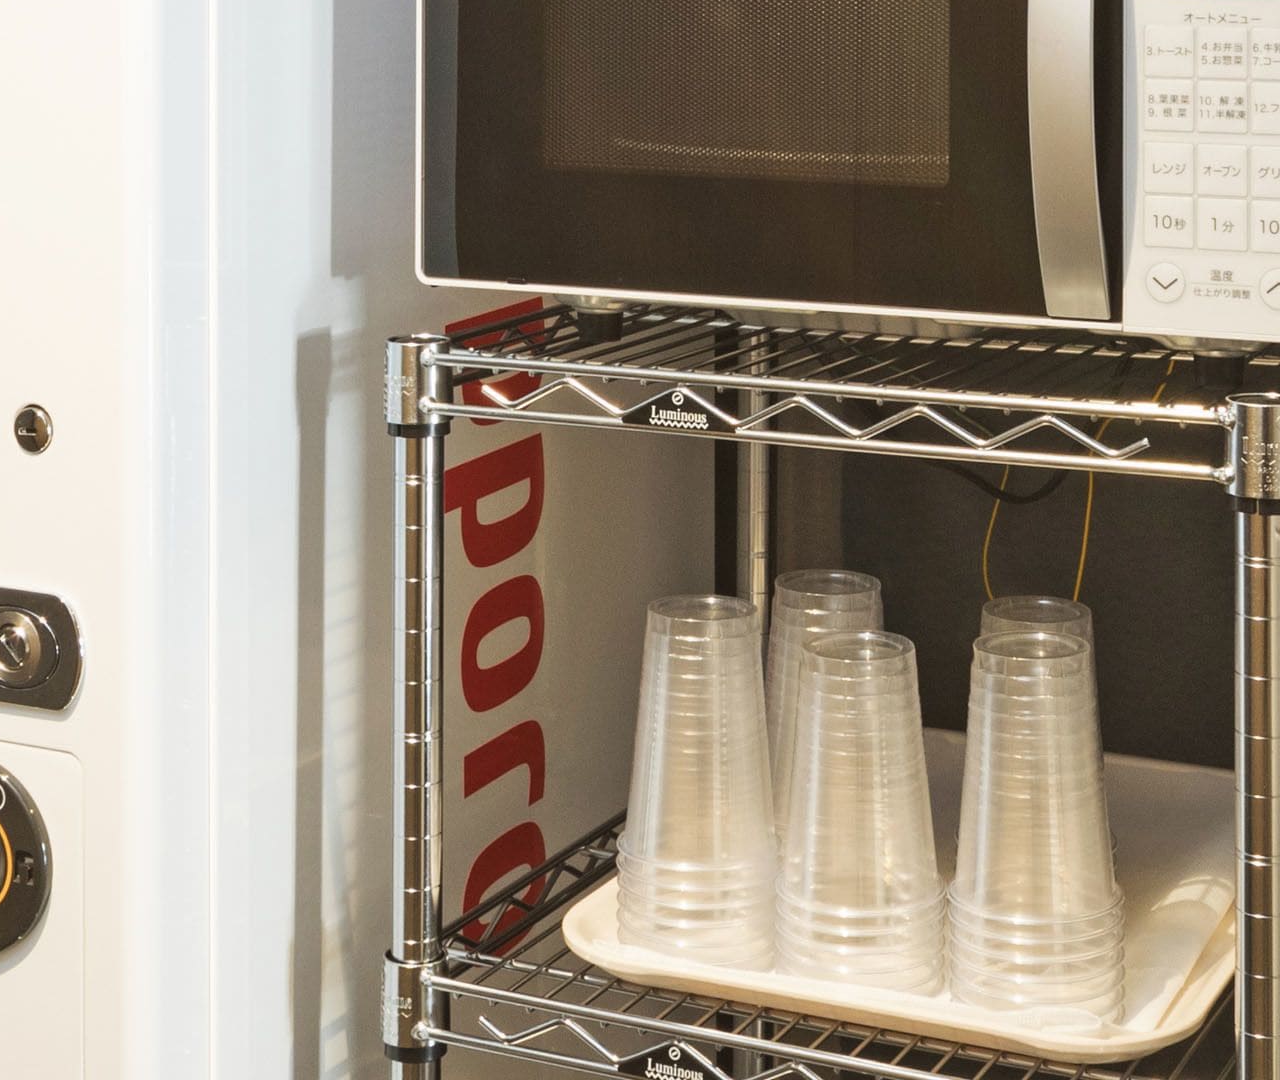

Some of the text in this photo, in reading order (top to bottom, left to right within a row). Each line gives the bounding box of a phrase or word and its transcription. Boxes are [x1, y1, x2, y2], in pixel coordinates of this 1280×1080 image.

[1184, 12, 1262, 25] オートメニュー
[1152, 163, 1187, 175] レンジ
[1202, 165, 1242, 178] オープン
[1152, 214, 1187, 231] 10秒
[1210, 217, 1235, 233] 1分
[1209, 269, 1234, 283] 温度
[650, 405, 707, 423] Luminous
